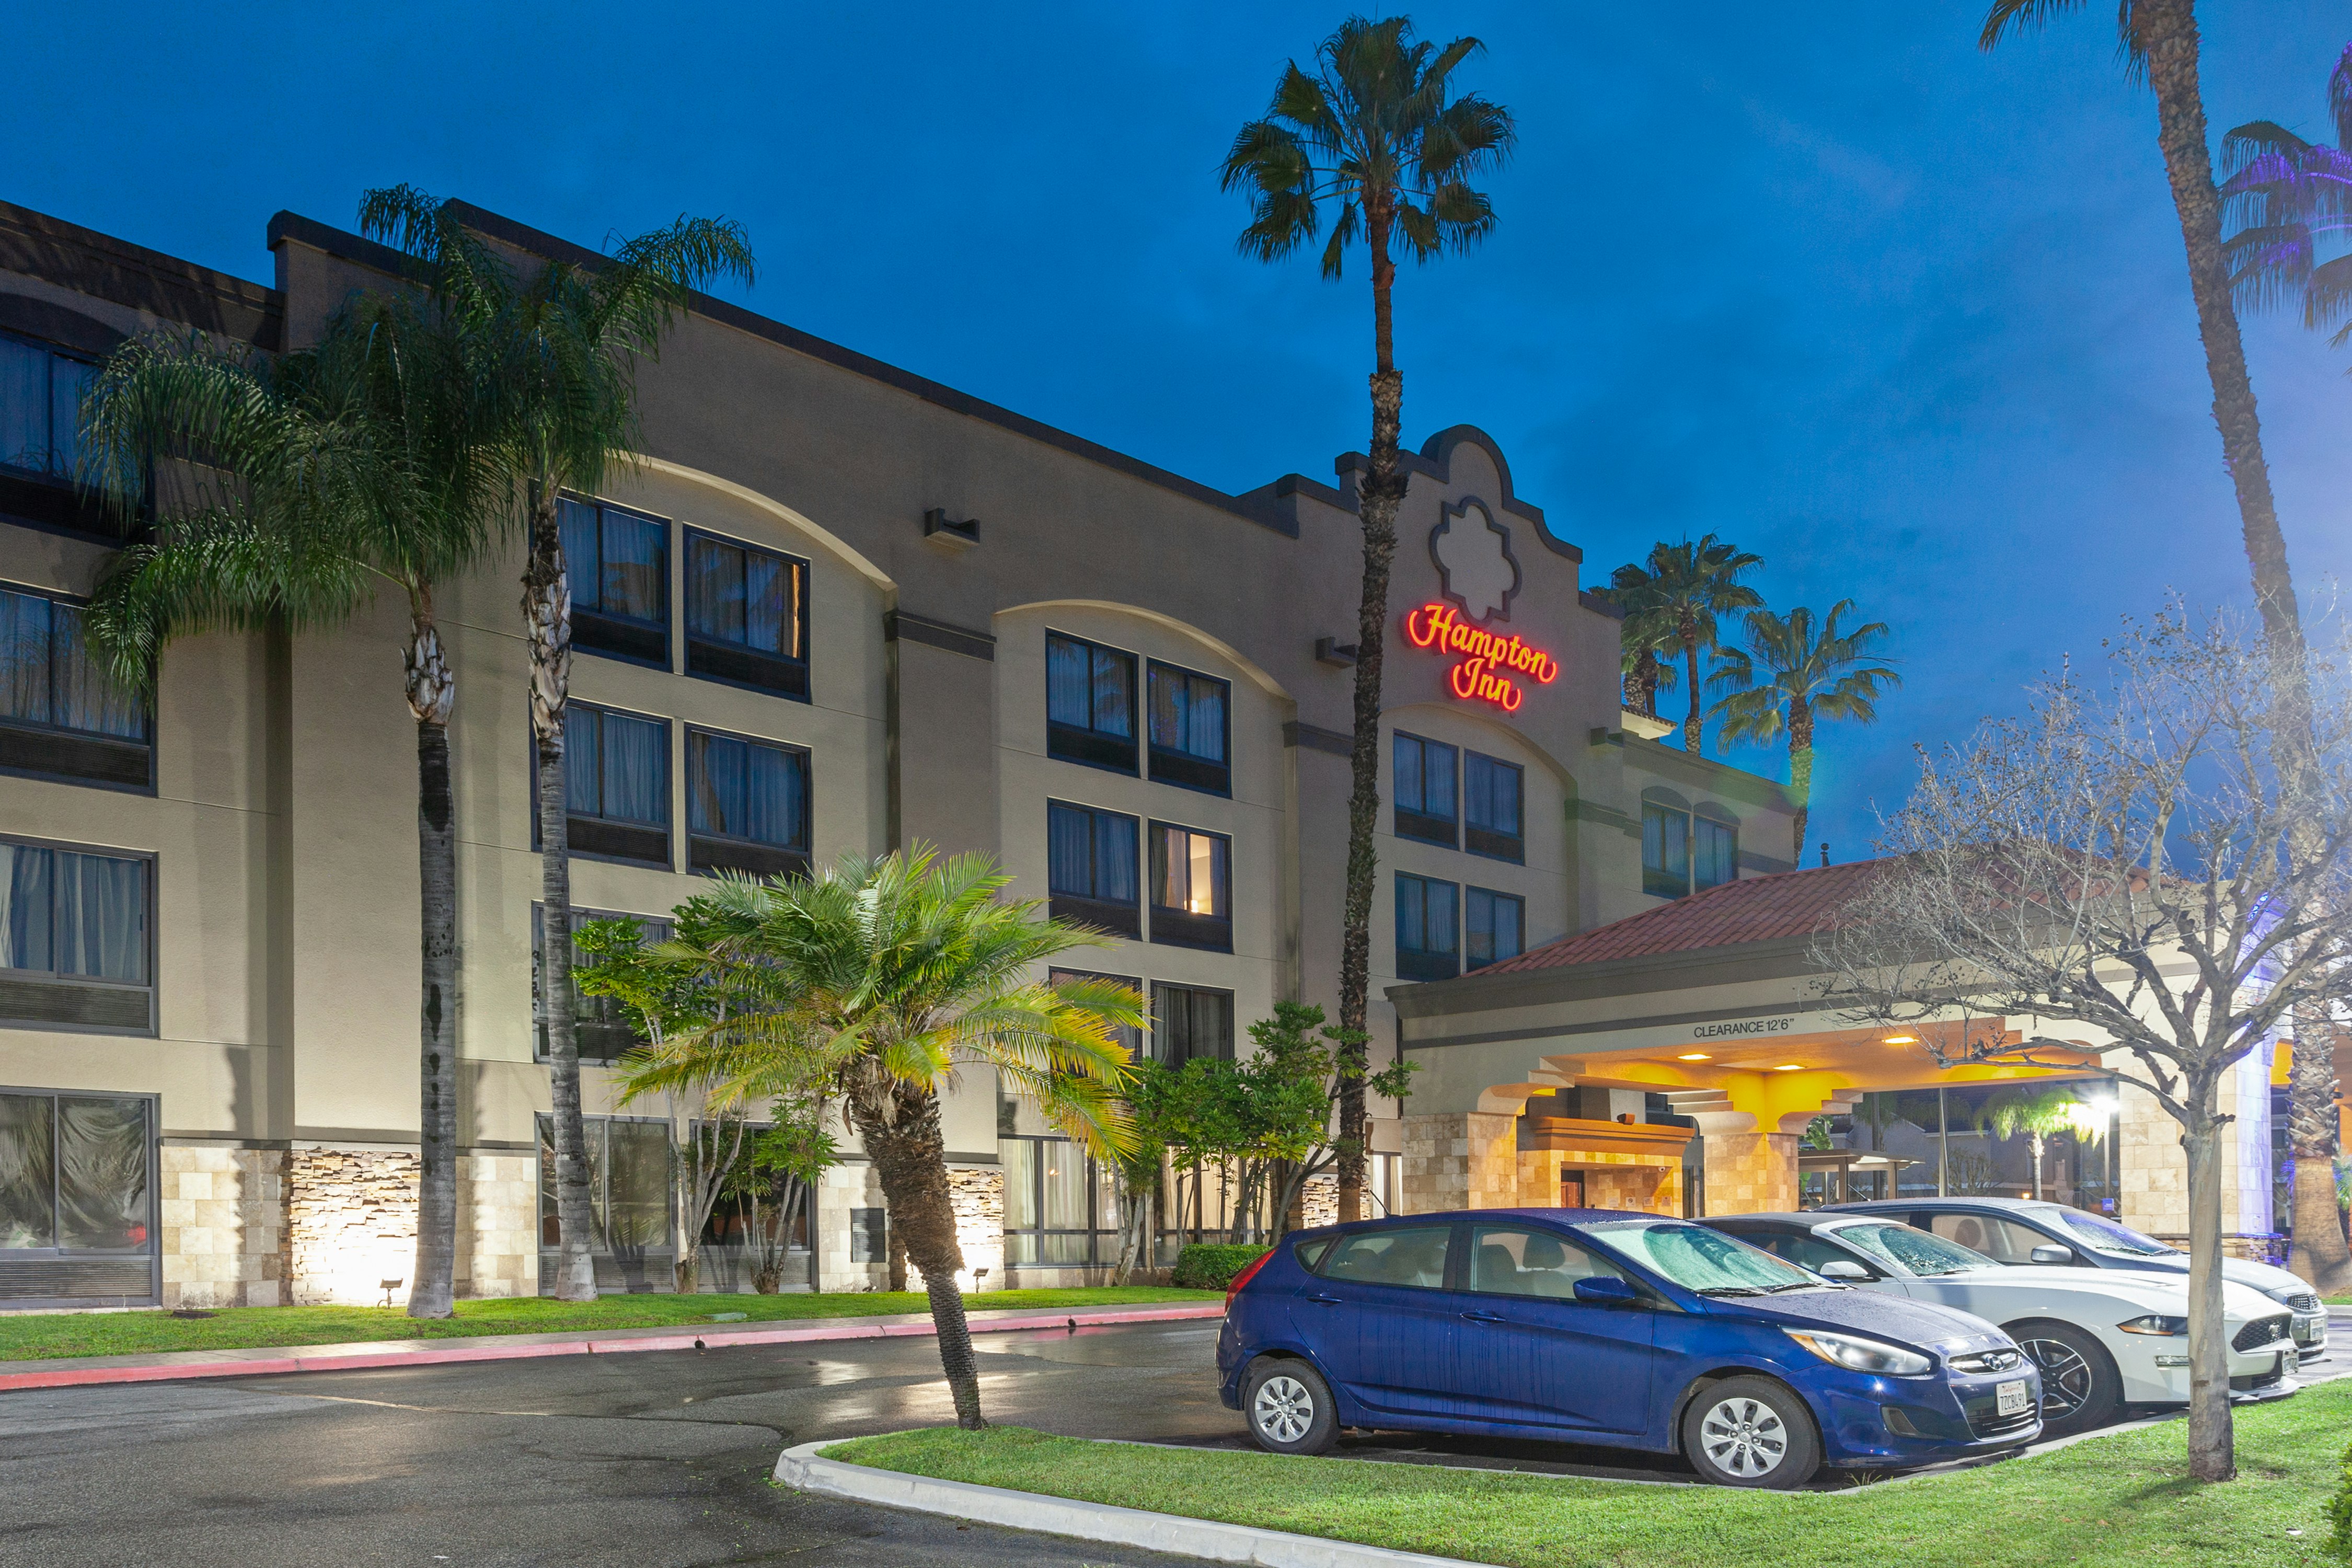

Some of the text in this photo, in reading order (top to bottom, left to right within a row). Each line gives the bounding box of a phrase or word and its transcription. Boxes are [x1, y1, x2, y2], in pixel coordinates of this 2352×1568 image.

[1409, 604, 1557, 683] Hampton
[1452, 658, 1522, 711] Inn
[1694, 1021, 1764, 1037] CLEARANCE
[2000, 1393, 2025, 1411] 7ZCB491
